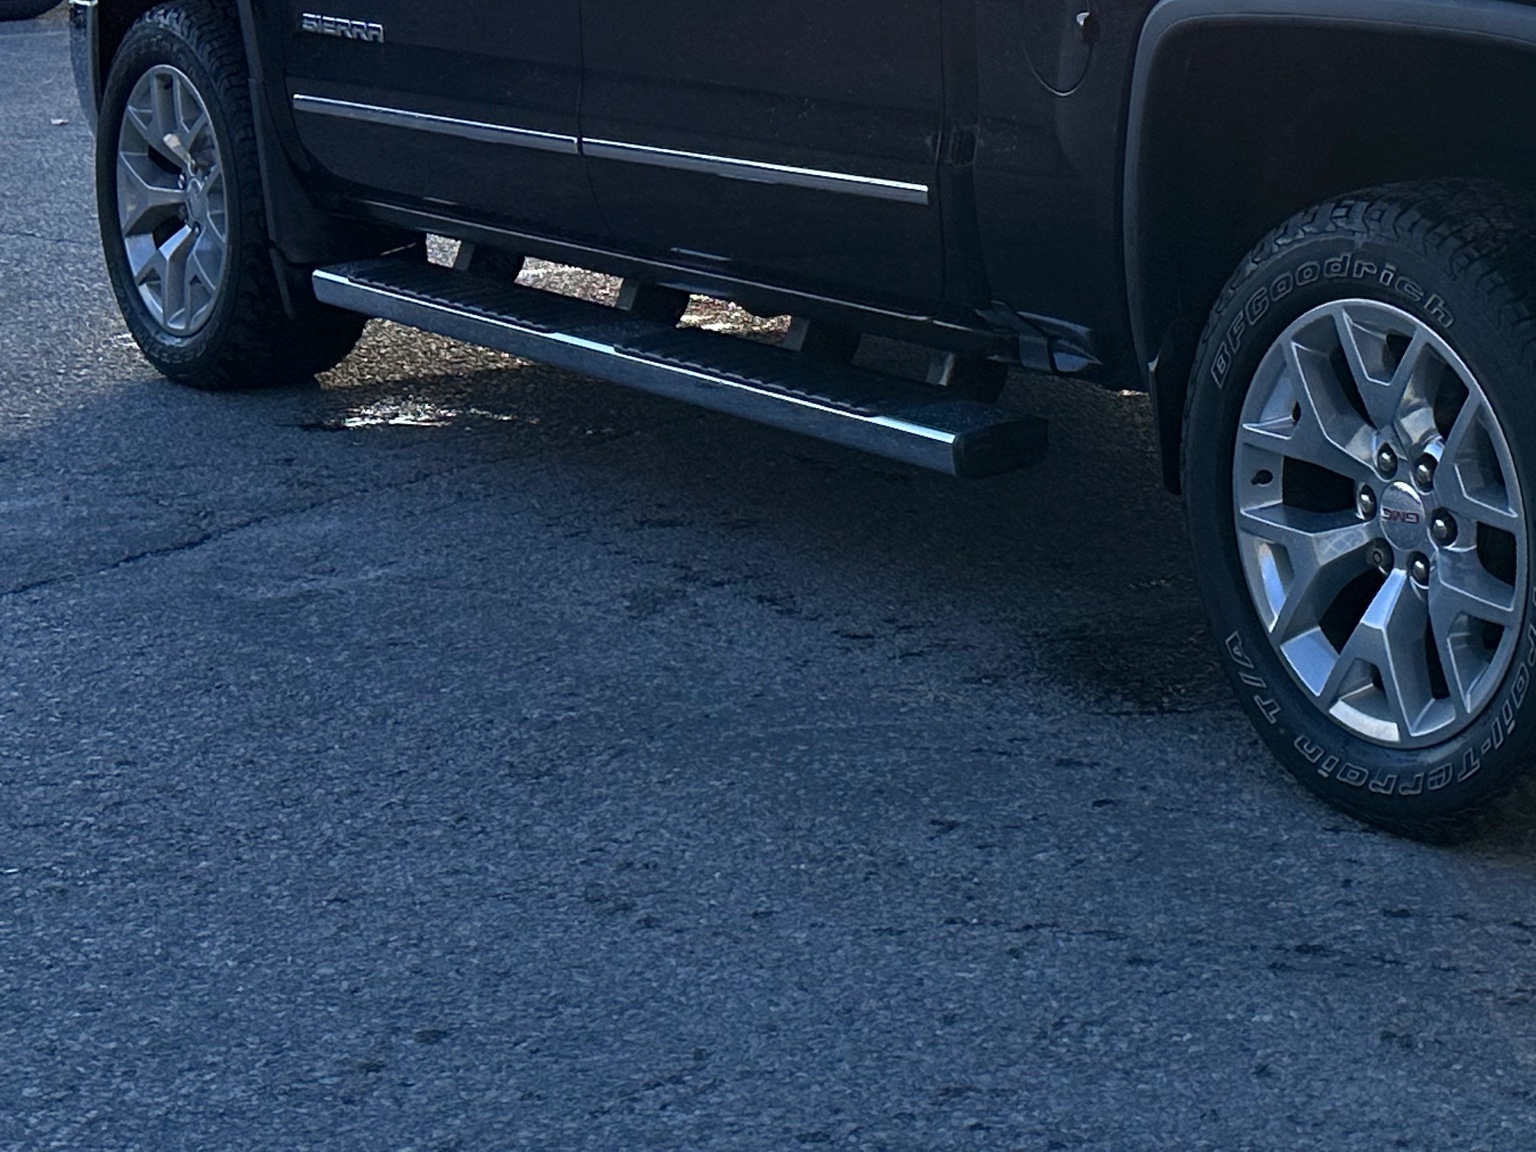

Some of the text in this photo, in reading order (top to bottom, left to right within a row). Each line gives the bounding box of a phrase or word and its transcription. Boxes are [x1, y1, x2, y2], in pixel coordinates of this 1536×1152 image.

[302, 12, 384, 43] SIERRA
[1210, 253, 1455, 390] BFGoodrich
[1381, 507, 1420, 524] GMC
